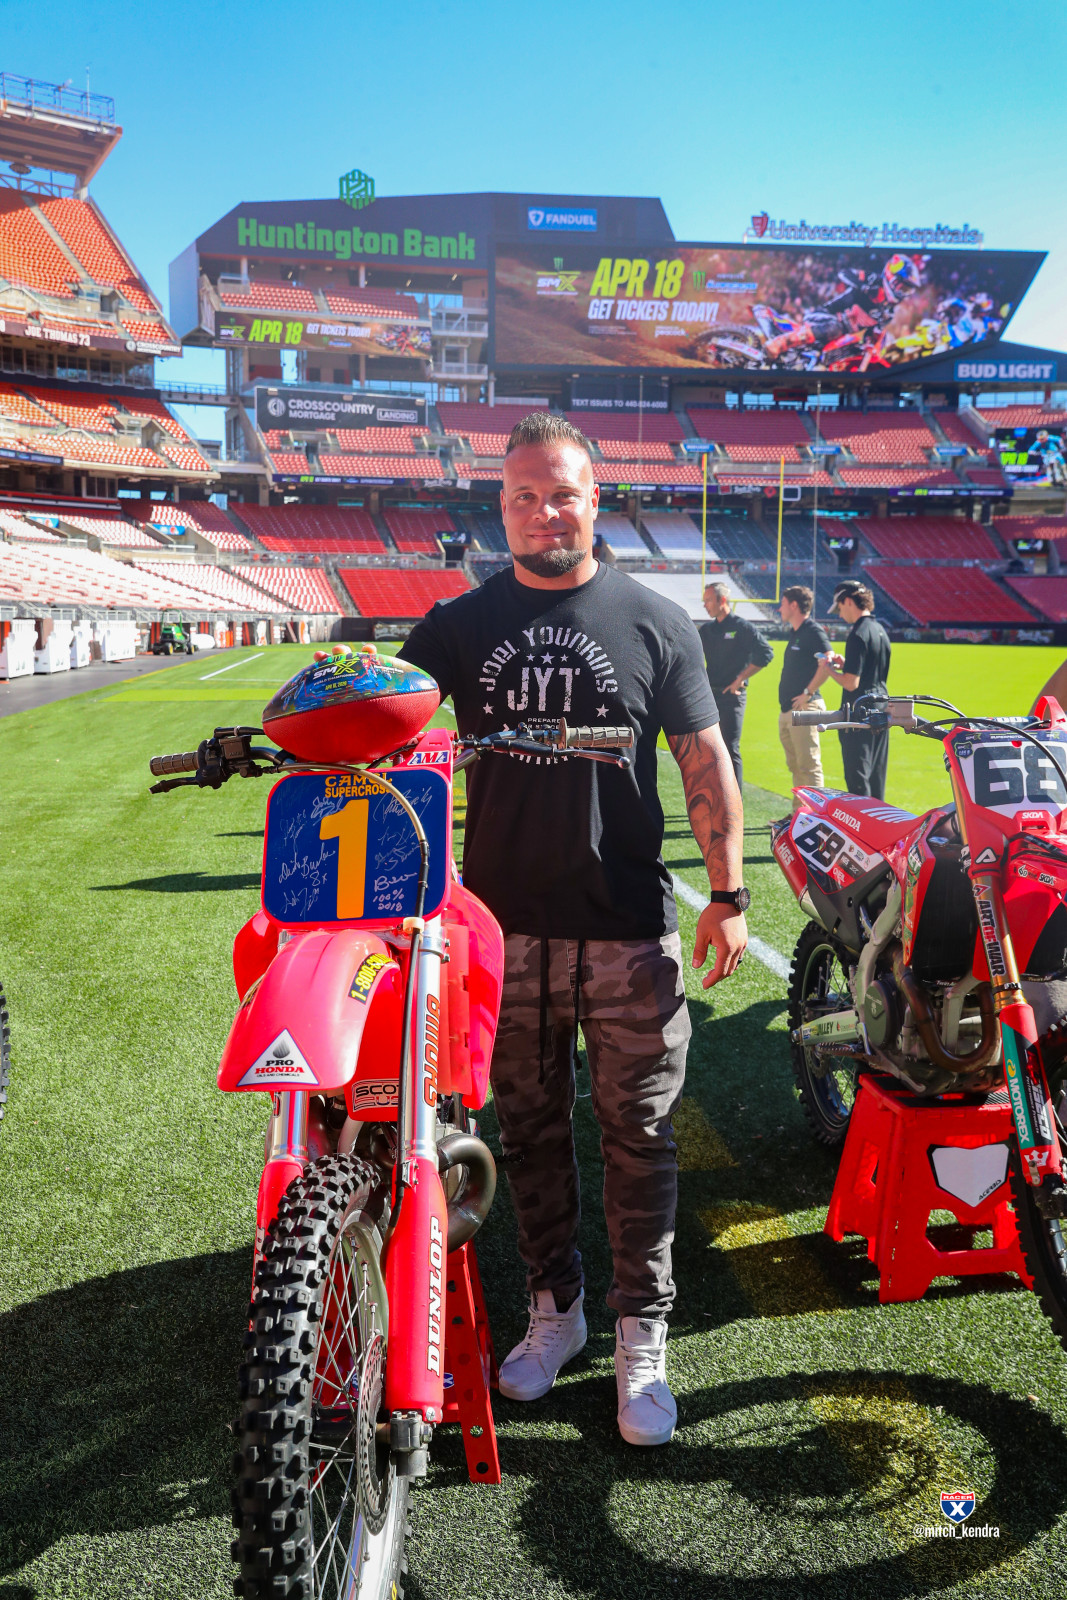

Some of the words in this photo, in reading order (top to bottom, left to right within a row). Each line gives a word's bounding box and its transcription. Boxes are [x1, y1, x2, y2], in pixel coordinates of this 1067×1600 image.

[546, 213, 596, 226] FANDUEL
[237, 217, 399, 260] Huntington
[403, 228, 476, 261] Bank
[769, 219, 878, 248] University
[882, 223, 980, 244] Hospitals
[537, 275, 578, 291] SMX
[589, 257, 650, 297] APR
[652, 259, 686, 300] 18
[587, 298, 615, 320] GET
[615, 299, 670, 321] TICKETS
[670, 301, 719, 322] TODAY!
[24, 325, 42, 338] JOE
[43, 327, 78, 344] THOMAS
[78, 334, 91, 347] 73
[248, 319, 283, 343] APR
[285, 321, 303, 345] 18
[306, 322, 319, 334] GET
[320, 323, 346, 337] TICKETS
[957, 364, 998, 379] BUD
[998, 364, 1053, 379] LIGHT
[288, 399, 375, 415] CROSSCOUNTRY
[572, 398, 589, 407] TEXT
[589, 399, 612, 407] ISSUES
[288, 410, 336, 421] MORTGAGE
[379, 412, 416, 423] LANDING
[313, 660, 358, 680] SMX
[479, 639, 521, 692] JOEL
[522, 626, 619, 693] YOUNKINS
[507, 666, 581, 712] JYT
[408, 751, 449, 765] AMA
[973, 745, 1067, 807] 68
[831, 808, 862, 832] HONDA
[1021, 811, 1044, 819] SKDA
[777, 842, 795, 866] HGS
[794, 822, 846, 868] 68
[319, 798, 370, 920] 1
[423, 993, 440, 1108] SHOWA
[254, 1066, 304, 1075] HONDA
[265, 1059, 294, 1067] PRO
[356, 1084, 399, 1097] SCO
[1009, 1078, 1030, 1144] MOTOREX
[427, 1215, 444, 1377] DUNLOP
